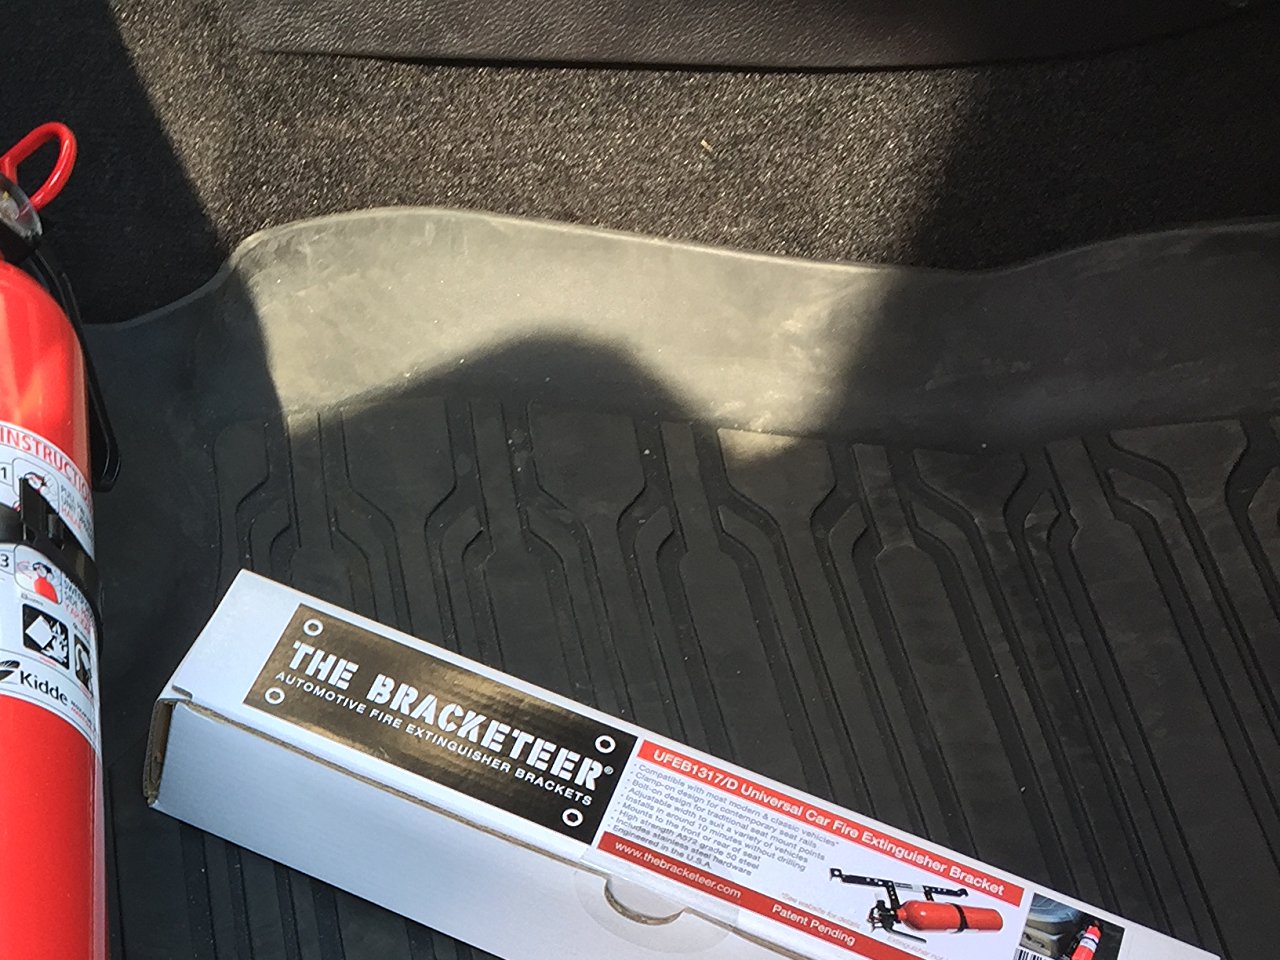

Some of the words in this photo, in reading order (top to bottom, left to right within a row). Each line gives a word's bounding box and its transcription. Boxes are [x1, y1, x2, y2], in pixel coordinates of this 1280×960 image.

[0, 466, 7, 480] 1
[0, 554, 9, 568] 3
[19, 670, 69, 706] Kidde
[286, 640, 359, 690] THE
[275, 671, 366, 715] AUTOMOTIVE
[369, 708, 402, 730] FIRE
[405, 723, 513, 774] EXTINGUISHER
[515, 767, 594, 807] BRACKETS
[627, 786, 672, 809] Adjustable
[672, 805, 697, 819] width
[697, 814, 707, 823] to
[708, 819, 725, 830] suit
[733, 829, 762, 846] variety
[762, 841, 773, 849] of
[773, 845, 808, 863] vehicles
[631, 778, 663, 796] Bolt-on
[663, 791, 691, 808] design
[692, 803, 705, 813] for
[706, 808, 749, 830] traditional
[749, 826, 769, 838] seat
[769, 834, 798, 850] mount
[797, 846, 825, 861] points
[634, 771, 676, 792] Clamp-on
[676, 787, 705, 804] design
[705, 799, 718, 809] for
[719, 805, 778, 834] contemporary
[778, 829, 798, 841] seat
[798, 837, 817, 848] rails
[637, 763, 685, 787] Compatible
[686, 783, 705, 795] with
[705, 791, 727, 804] most
[728, 800, 761, 817] modern
[761, 812, 770, 820] &
[769, 816, 800, 832] classic
[651, 748, 739, 791] UFEB1317/D
[739, 782, 804, 816] Universal
[803, 807, 831, 827] Car
[831, 818, 859, 839] Fire
[860, 829, 947, 873] Extinguisher
[948, 863, 1005, 896] Bracket
[612, 823, 659, 847] Engineered
[660, 843, 669, 851] in
[670, 847, 684, 857] the
[615, 816, 651, 836] Includes
[651, 832, 689, 851] stainless
[689, 847, 712, 860] steel
[711, 855, 752, 876] hardware
[618, 809, 639, 822] High
[639, 818, 675, 836] strength
[698, 842, 724, 856] grade
[724, 851, 737, 861] 50
[737, 857, 760, 870] steel
[621, 801, 653, 819] Mounts
[653, 814, 664, 823] to
[664, 818, 680, 829] the
[680, 825, 701, 838] front
[701, 834, 711, 842] or
[712, 839, 730, 850] rear
[730, 846, 741, 854] of
[741, 850, 761, 862] seat
[625, 794, 654, 811] Installs
[655, 806, 664, 815] in
[664, 811, 695, 827] around
[697, 822, 708, 832] 10
[708, 828, 742, 846] minutes
[743, 842, 776, 859] without
[776, 854, 806, 872] drilling
[612, 839, 742, 899] www.thebracketeer.com
[770, 902, 810, 927] Patent
[808, 917, 857, 948] Pending
